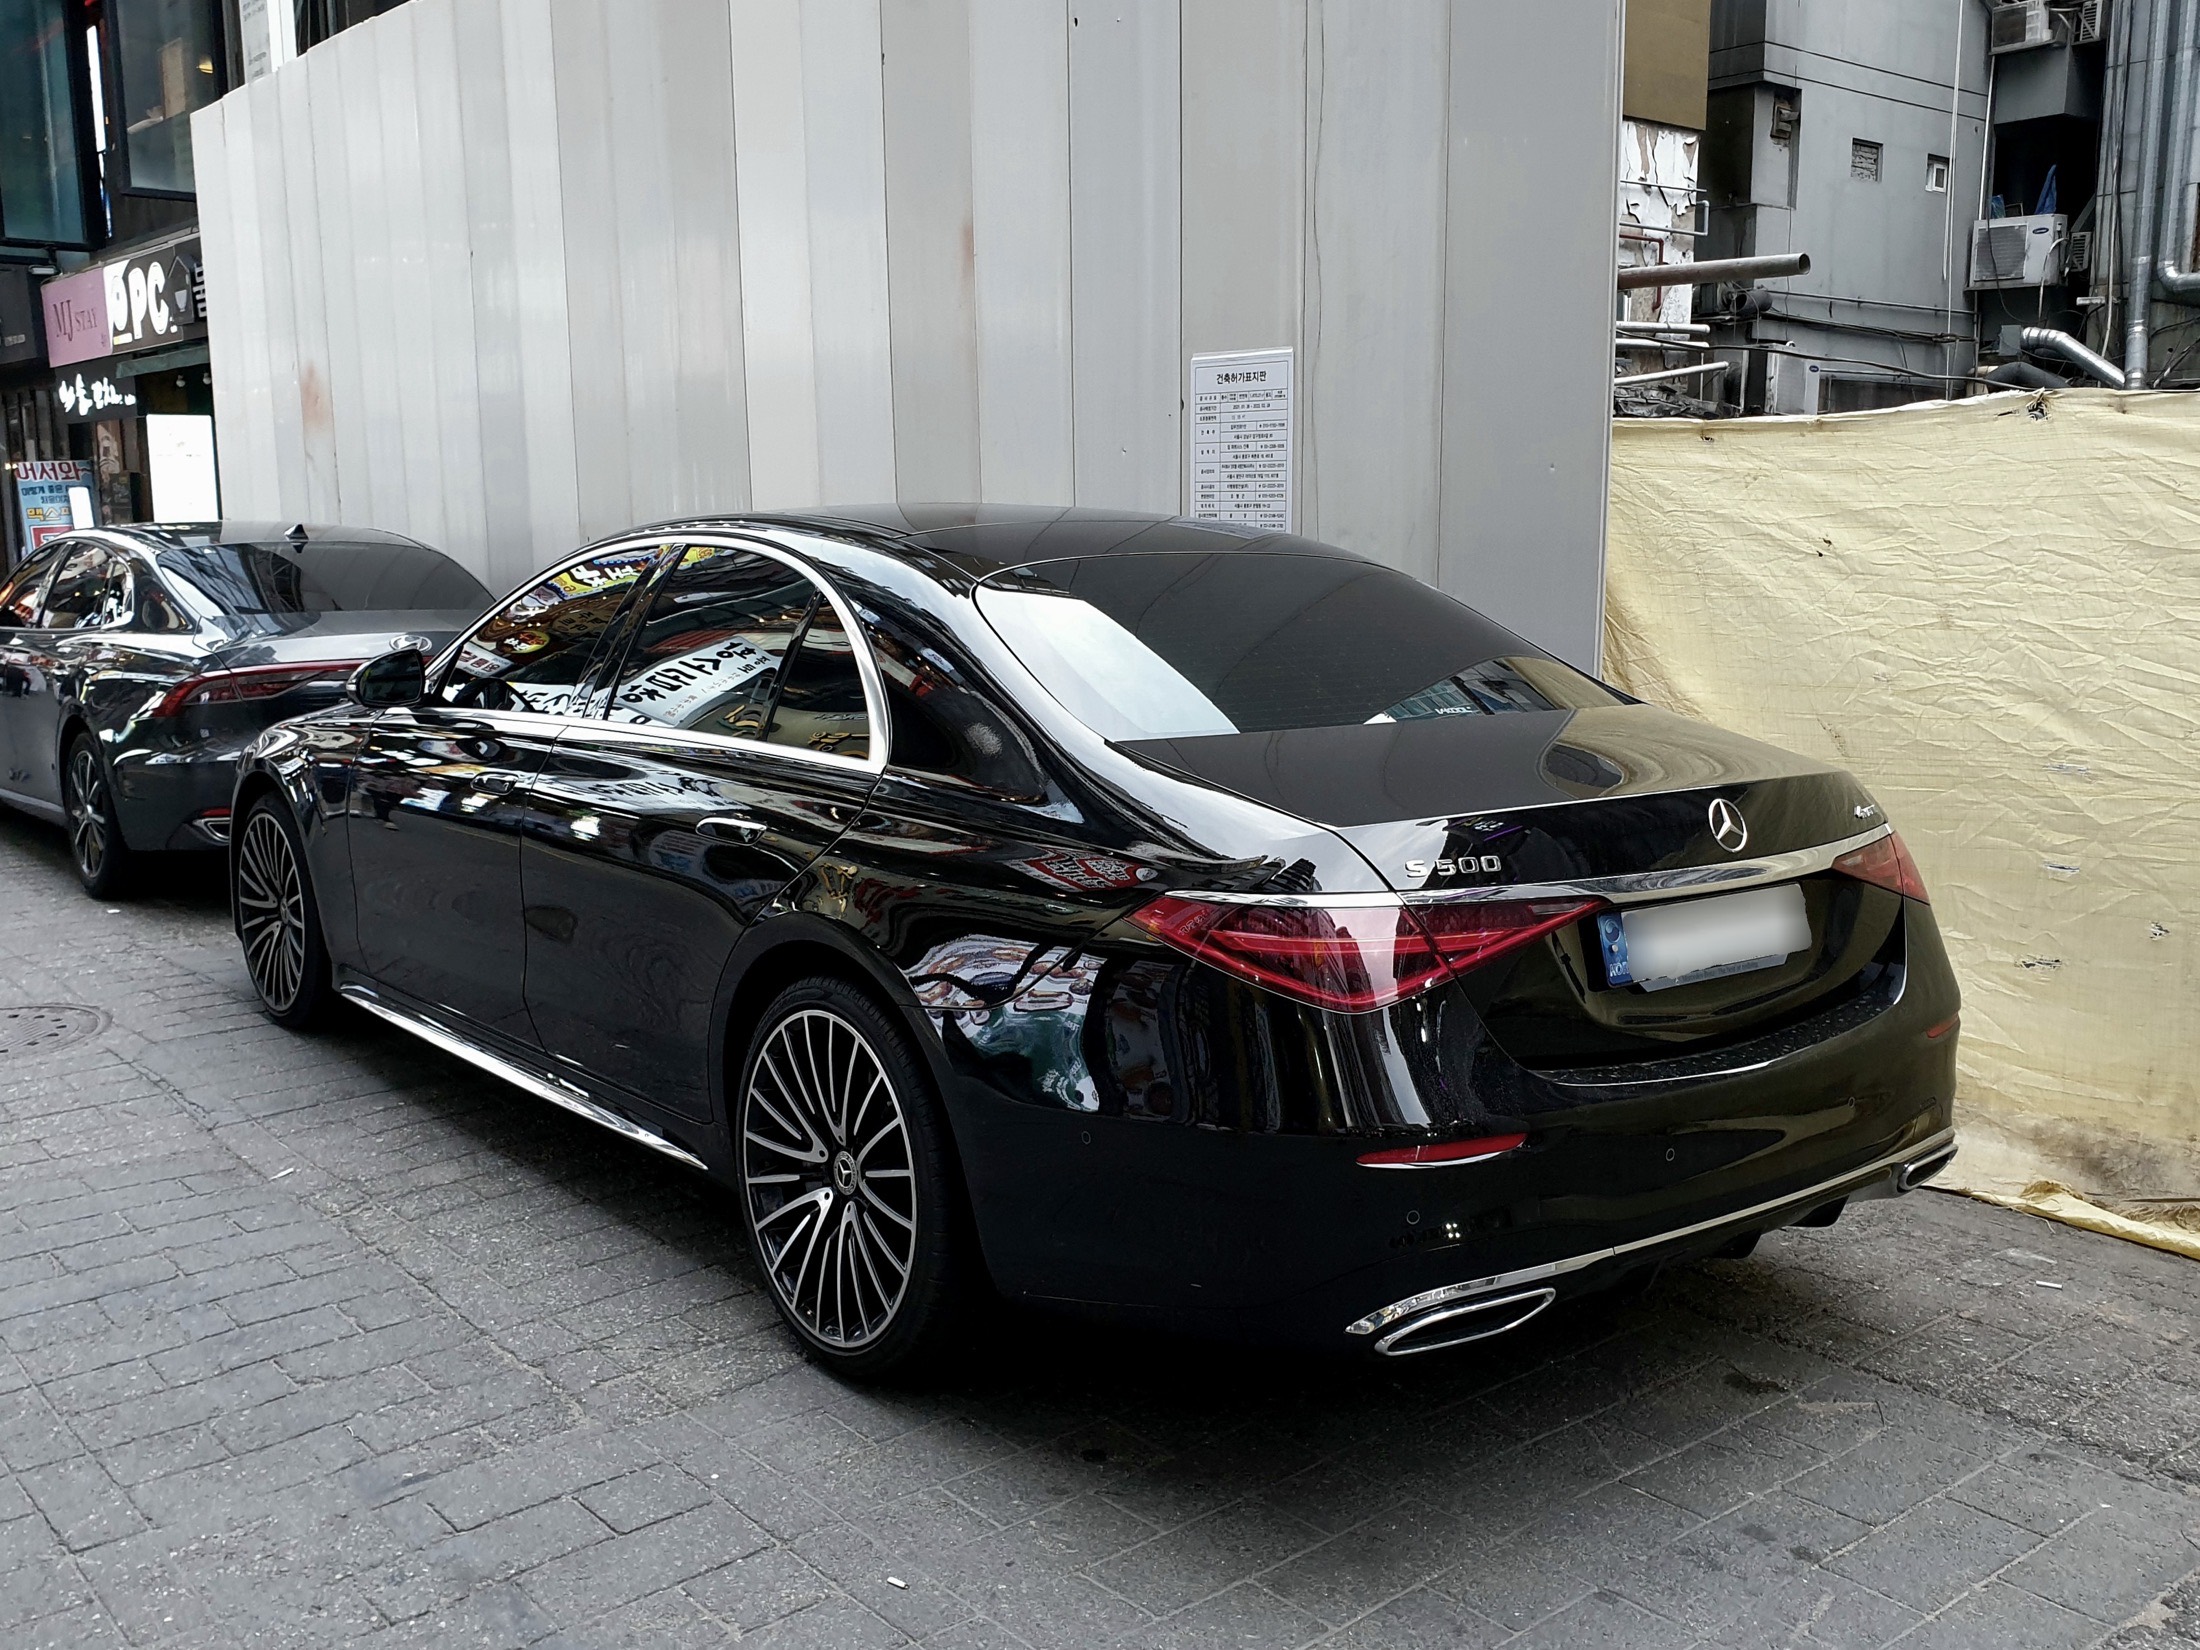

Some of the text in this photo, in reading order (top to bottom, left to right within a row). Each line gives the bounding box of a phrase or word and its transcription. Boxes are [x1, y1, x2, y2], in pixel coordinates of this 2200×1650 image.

[1216, 370, 1267, 385] 건축허가표지판
[1405, 855, 1502, 878] S 500
